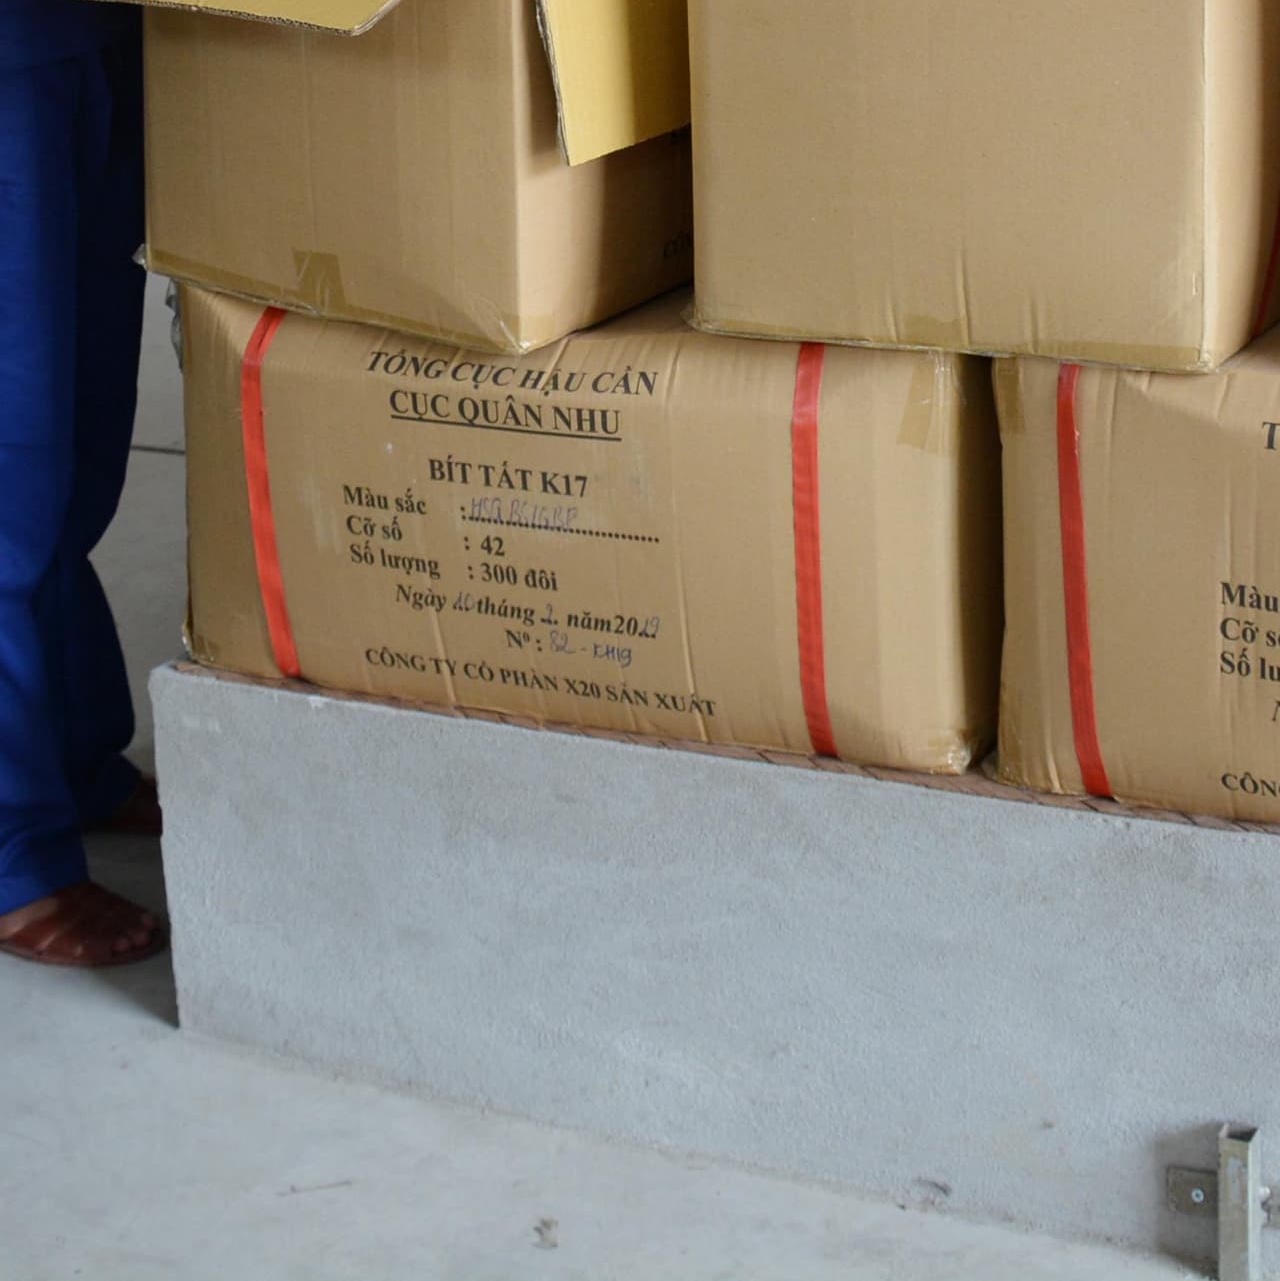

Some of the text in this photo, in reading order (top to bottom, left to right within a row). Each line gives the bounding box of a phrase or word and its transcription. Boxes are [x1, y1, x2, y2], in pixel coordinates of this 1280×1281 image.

[367, 350, 449, 380] TỔNG
[451, 361, 516, 392] CỤC
[517, 368, 586, 397] HẬU
[389, 389, 621, 435] CỤC QUÂN NHU
[429, 454, 472, 484] BÍT
[540, 471, 588, 499] K17
[342, 484, 389, 511] Màu
[395, 488, 427, 516] sắc
[346, 514, 375, 537] Cỡ
[382, 516, 402, 541] số
[480, 535, 505, 557] 42
[350, 540, 375, 565] Số
[381, 548, 441, 580] lượng
[481, 561, 518, 585] 300
[524, 565, 559, 591] đôi
[396, 583, 447, 610] Ngày
[476, 596, 536, 627] tháng
[1220, 581, 1279, 614] Màu
[1220, 614, 1260, 644] Cỡ
[365, 646, 426, 672] CÔNG
[429, 657, 457, 677] TY
[501, 663, 559, 692] PHẦN
[565, 679, 601, 701] X20
[606, 678, 649, 707] SẢN
[656, 690, 716, 717] XUẤT
[1220, 647, 1252, 678] Số
